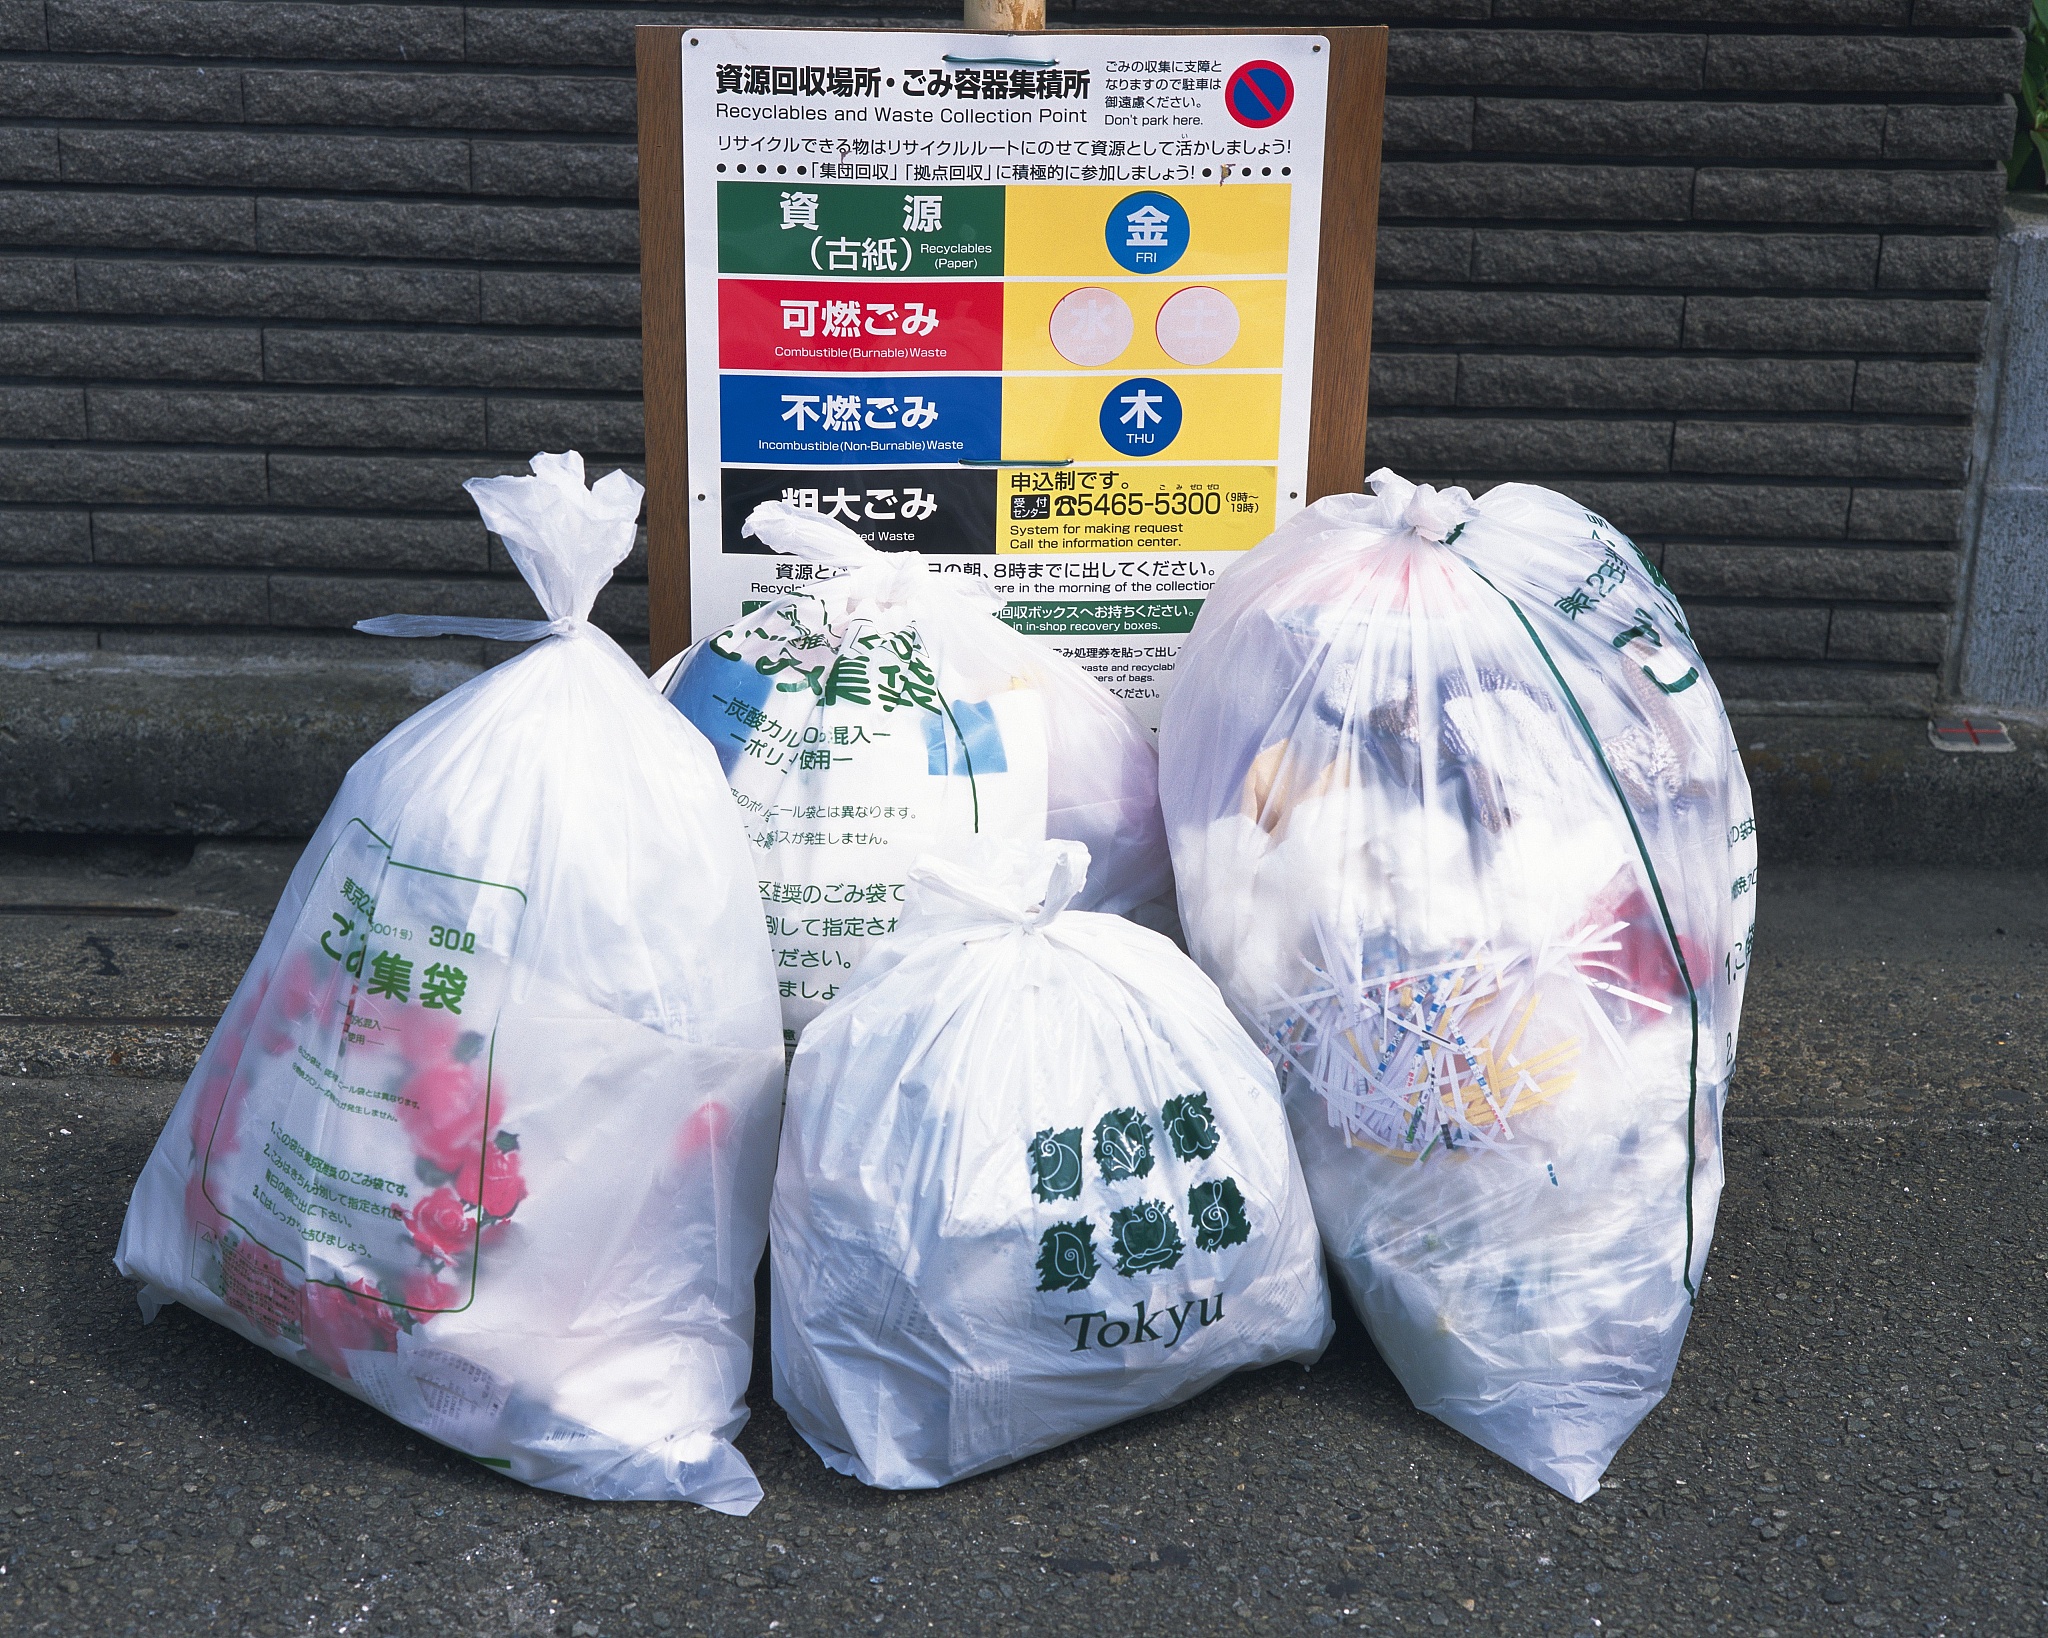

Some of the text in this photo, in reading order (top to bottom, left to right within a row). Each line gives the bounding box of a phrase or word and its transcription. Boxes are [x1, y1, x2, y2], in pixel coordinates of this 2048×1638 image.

[1105, 60, 1222, 73] ごみの収集に支障と
[716, 63, 1090, 99] 資源回収場所・ごみ容器集積所
[1105, 77, 1222, 91] なりますので駐車は
[1104, 96, 1202, 109] 御遠慮ください。
[716, 103, 1088, 123] Recyclables and Waste Collection Point
[1104, 114, 1203, 127] Don't park here.
[1126, 205, 1170, 247] 金
[920, 243, 992, 255] Recyclables
[934, 258, 978, 270] (Paper)
[1136, 252, 1157, 263] FRI
[780, 300, 940, 338] 可燃ごみ
[781, 394, 939, 432] 不燃ごみ
[1119, 389, 1163, 429] 木
[1126, 433, 1154, 444] THU
[1010, 471, 1130, 493] 申込制です。
[1077, 492, 1221, 516] 5465-5300
[1230, 502, 1260, 514] 19時)
[1013, 508, 1048, 518] センター
[1010, 522, 1184, 537] System for making request
[857, 531, 915, 542] ed Waste
[1010, 536, 1182, 549] Call the information center.
[1018, 583, 1030, 593] in
[1033, 582, 1055, 593] the
[1059, 582, 1111, 594] morning
[1114, 582, 1128, 592] of
[1131, 581, 1152, 592] the
[1012, 620, 1161, 632] in in-shop recovery boxes.
[1111, 663, 1129, 672] and
[1116, 674, 1127, 682] of
[1128, 674, 1156, 684] bags.
[1064, 1292, 1226, 1352] Tokyu
